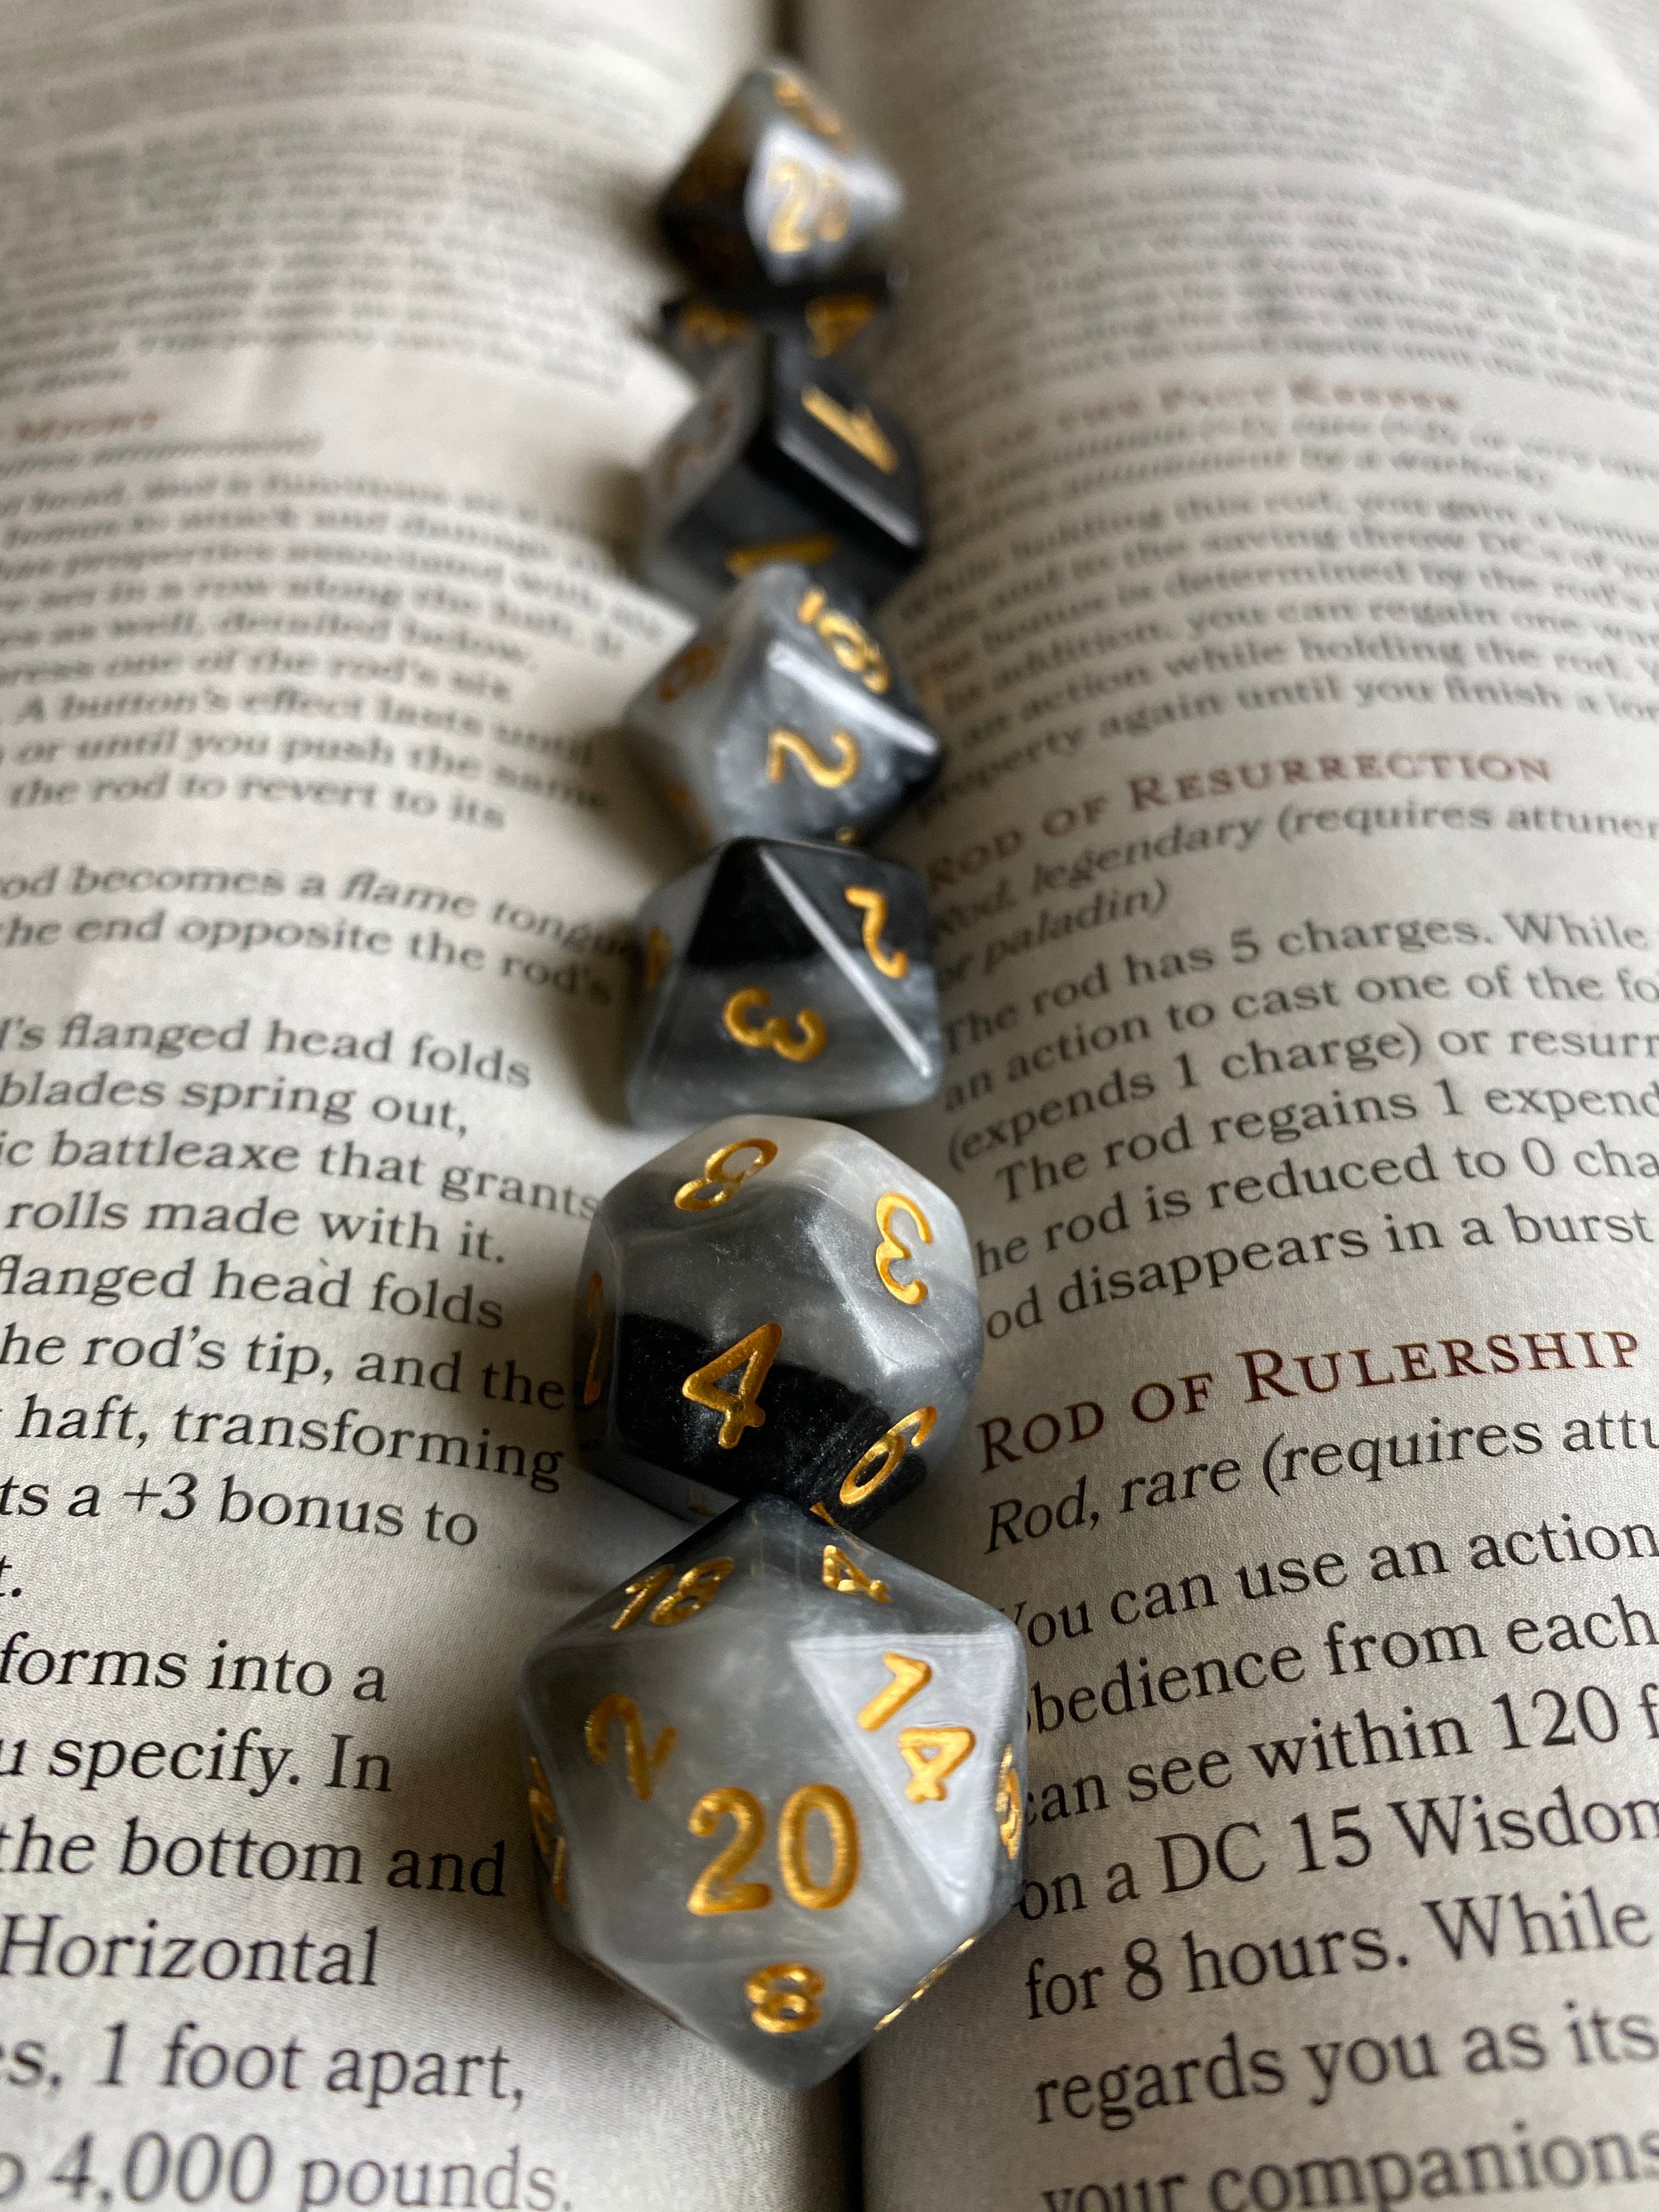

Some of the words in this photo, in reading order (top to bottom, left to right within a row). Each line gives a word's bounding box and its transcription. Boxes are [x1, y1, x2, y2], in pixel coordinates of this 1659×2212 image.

[10, 774, 80, 808] the
[89, 767, 172, 802] rod
[178, 769, 227, 799] to
[236, 774, 378, 810] revert
[392, 783, 439, 818] to
[450, 791, 507, 831] its
[76, 725, 179, 761] until
[179, 730, 271, 762] you
[277, 736, 395, 768] push
[408, 742, 483, 781] the
[1034, 810, 1262, 894] legendary
[1276, 795, 1495, 844] (requires
[72, 864, 287, 897] becomes
[296, 872, 327, 899] a
[341, 867, 479, 919] flame
[74, 908, 167, 943] end
[178, 914, 393, 953] opposite
[408, 929, 487, 971] the
[1032, 960, 1111, 1017] rod
[1124, 947, 1215, 987] has
[1230, 927, 1260, 965] 5
[1277, 918, 1495, 958] charges.
[1501, 910, 1650, 950] While
[59, 1011, 253, 1060] flanged
[266, 1017, 393, 1064] head
[408, 1031, 531, 1089] folds
[722, 986, 827, 1062] 3
[945, 1066, 994, 1112] an
[1006, 1014, 1151, 1083] action
[1166, 1001, 1215, 1033] to
[1231, 978, 1341, 1020] cast
[1355, 971, 1452, 1004] one
[1465, 961, 1513, 999] of
[1525, 964, 1606, 1002] the
[1, 1070, 165, 1107] blades
[180, 1076, 357, 1125] spring
[371, 1094, 467, 1139] out,
[947, 1067, 1157, 1174] (expends
[1174, 1051, 1200, 1089] 1
[1220, 1022, 1422, 1081] charge)
[1437, 1029, 1489, 1057] or
[995, 1151, 1089, 1204] The
[1103, 1113, 1194, 1169] rod
[1210, 1089, 1418, 1146] regains
[1433, 1077, 1464, 1116] 1
[49, 1128, 301, 1173] battleaxe
[319, 1140, 426, 1187] that
[439, 1164, 602, 1221] grants
[673, 1137, 779, 1212] 8
[1043, 1189, 1130, 1253] rod
[1144, 1183, 1192, 1224] is
[1206, 1142, 1440, 1210] reduced
[1452, 1144, 1506, 1179] to
[1520, 1136, 1556, 1178] 0
[5, 1190, 128, 1230] rolls
[145, 1195, 299, 1236] made
[319, 1206, 440, 1253] with
[457, 1220, 505, 1264] it.
[874, 1192, 933, 1305] 3
[1057, 1227, 1370, 1315] disappears
[1382, 1212, 1444, 1253] in
[1460, 1216, 1494, 1248] a
[1503, 1203, 1654, 1245] burst
[211, 1257, 352, 1308] head
[367, 1271, 504, 1329] folds
[82, 1324, 226, 1371] rod's
[246, 1331, 334, 1385] tip,
[355, 1350, 462, 1394] and
[481, 1359, 566, 1411] the
[682, 1323, 782, 1450] 4
[15, 1392, 149, 1449] haft,
[173, 1404, 563, 1495] transforming
[983, 1475, 1102, 1556] Rod,
[1119, 1456, 1241, 1514] rare
[1261, 1416, 1544, 1497] (requires
[68, 1483, 100, 1517] a
[123, 1471, 198, 1521] +3
[220, 1475, 404, 1537] bonus
[425, 1500, 479, 1547] to
[1110, 1571, 1220, 1624] can
[1235, 1551, 1348, 1600] use
[1369, 1537, 1450, 1582] an
[1468, 1513, 1659, 1571] action
[206, 1639, 333, 1697] into
[352, 1664, 389, 1703] a
[1026, 1644, 1305, 1735] bedience
[1324, 1620, 1489, 1676] from
[1506, 1593, 1659, 1654] each
[49, 1726, 301, 1798] specify.
[324, 1733, 393, 1793] In
[1127, 1747, 1231, 1803] see
[1249, 1705, 1474, 1778] within
[1491, 1685, 1621, 1752] 120
[119, 1815, 364, 1885] bottom
[386, 1839, 506, 1898] and
[687, 1783, 860, 1916] 20
[1013, 1871, 1088, 1921] on
[1106, 1860, 1141, 1904] a
[1155, 1821, 1267, 1895] DC
[1290, 1804, 1372, 1874] 15
[0, 1913, 379, 1986] Horizontal
[1026, 1956, 1104, 2020] for
[1124, 1937, 1163, 2001] 8
[1181, 1926, 1409, 1992] hours.
[1421, 1885, 1654, 1962] While
[743, 1961, 827, 2034] 8
[95, 2019, 128, 2087] 1
[160, 2021, 306, 2091] foot
[326, 2045, 525, 2110] apart,
[1034, 2031, 1287, 2131] regards
[1301, 2031, 1440, 2107] you
[1463, 2022, 1548, 2076] as
[1563, 1999, 1659, 2066] its
[49, 2130, 274, 2206] 4,000
[299, 2144, 574, 2212] pounds.
